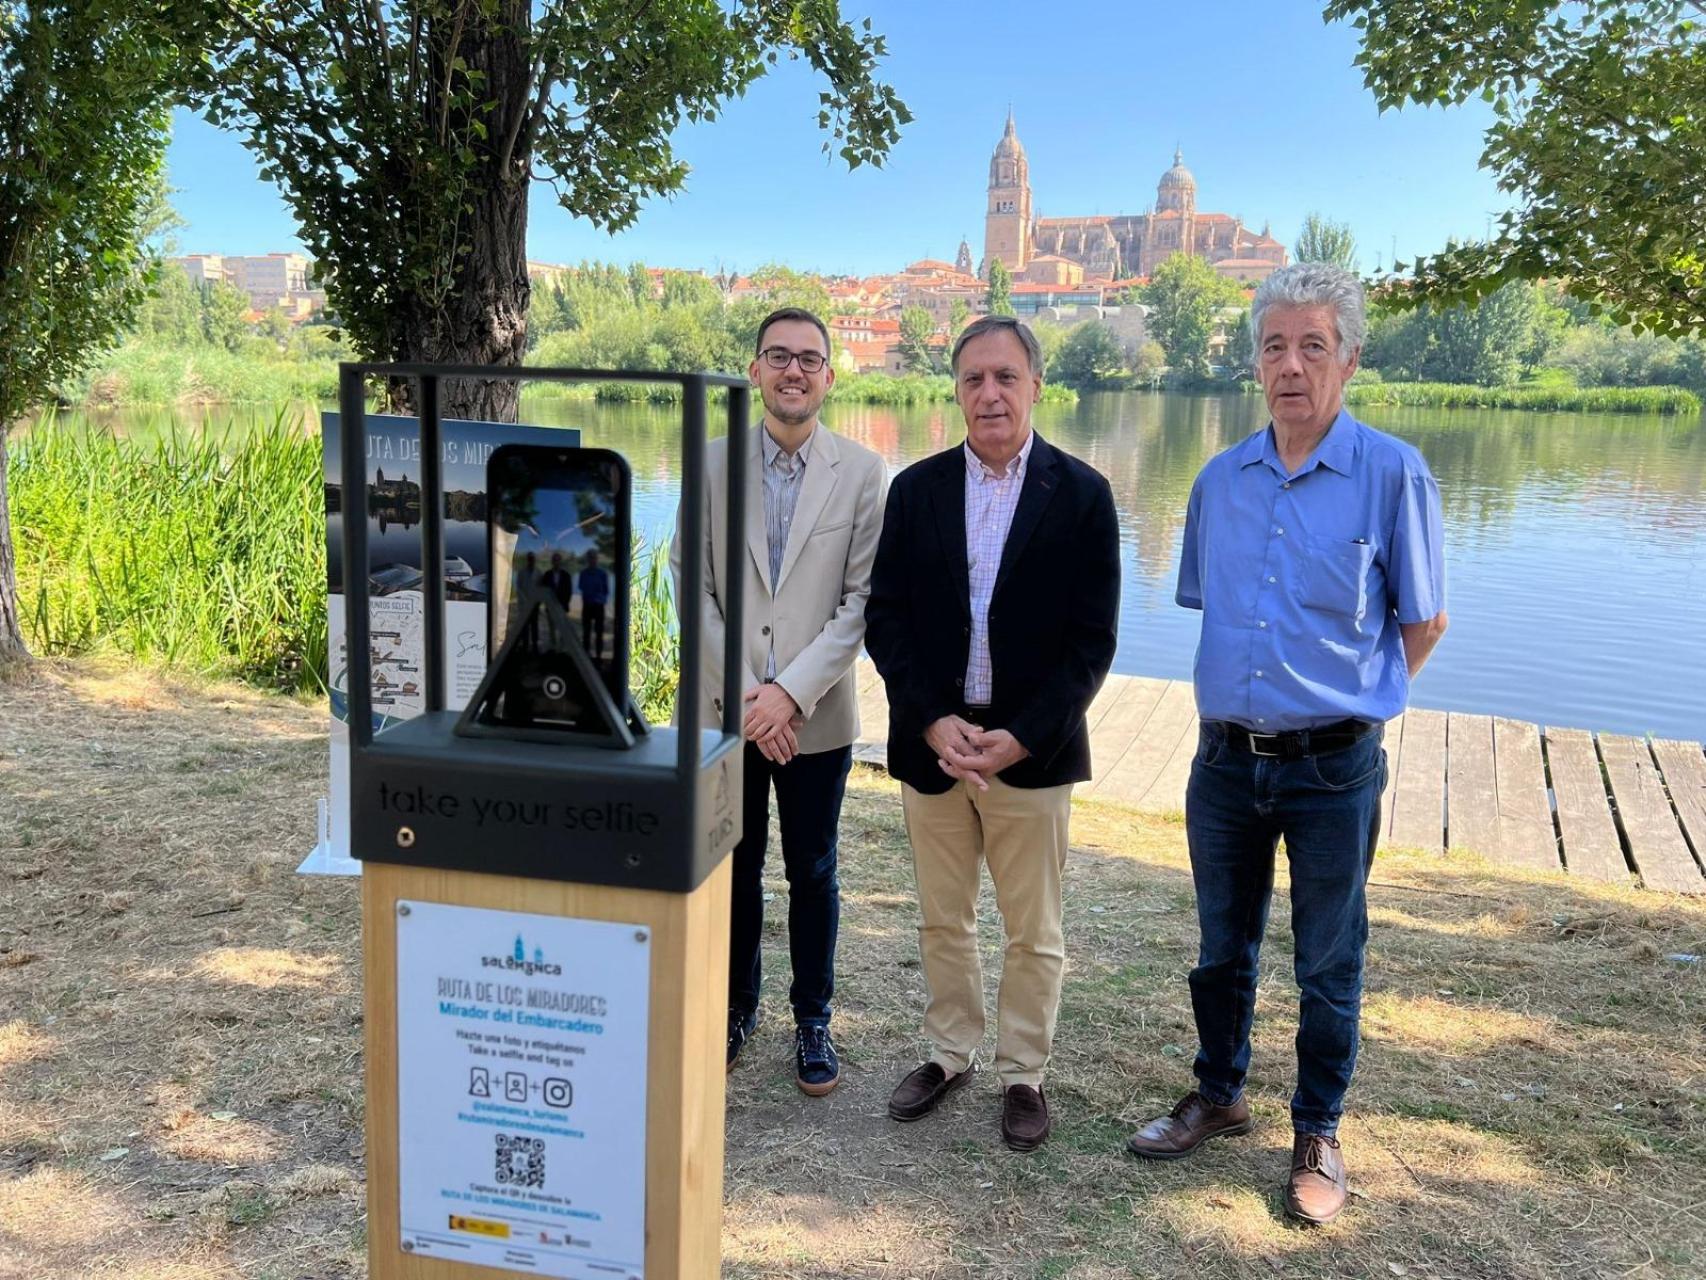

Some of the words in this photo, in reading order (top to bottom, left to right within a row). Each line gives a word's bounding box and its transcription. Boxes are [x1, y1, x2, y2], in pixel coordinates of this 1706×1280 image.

[378, 782, 459, 817] take
[472, 797, 551, 827] your
[562, 803, 660, 836] selfie
[438, 977, 471, 1000] RUTA
[476, 982, 493, 1003] DE
[497, 984, 523, 1007] LOS
[527, 987, 607, 1017] MIRADORES
[440, 1001, 489, 1019] Mirador
[493, 1008, 512, 1022] del
[516, 1011, 604, 1035] Embarcadero
[456, 1029, 482, 1041] Hazte
[484, 1034, 501, 1044] una
[503, 1035, 522, 1047] foto
[524, 1040, 529, 1049] y
[468, 1043, 488, 1056] Take
[499, 1048, 524, 1060] selfie
[526, 1053, 543, 1063] and
[546, 1055, 561, 1067] tag
